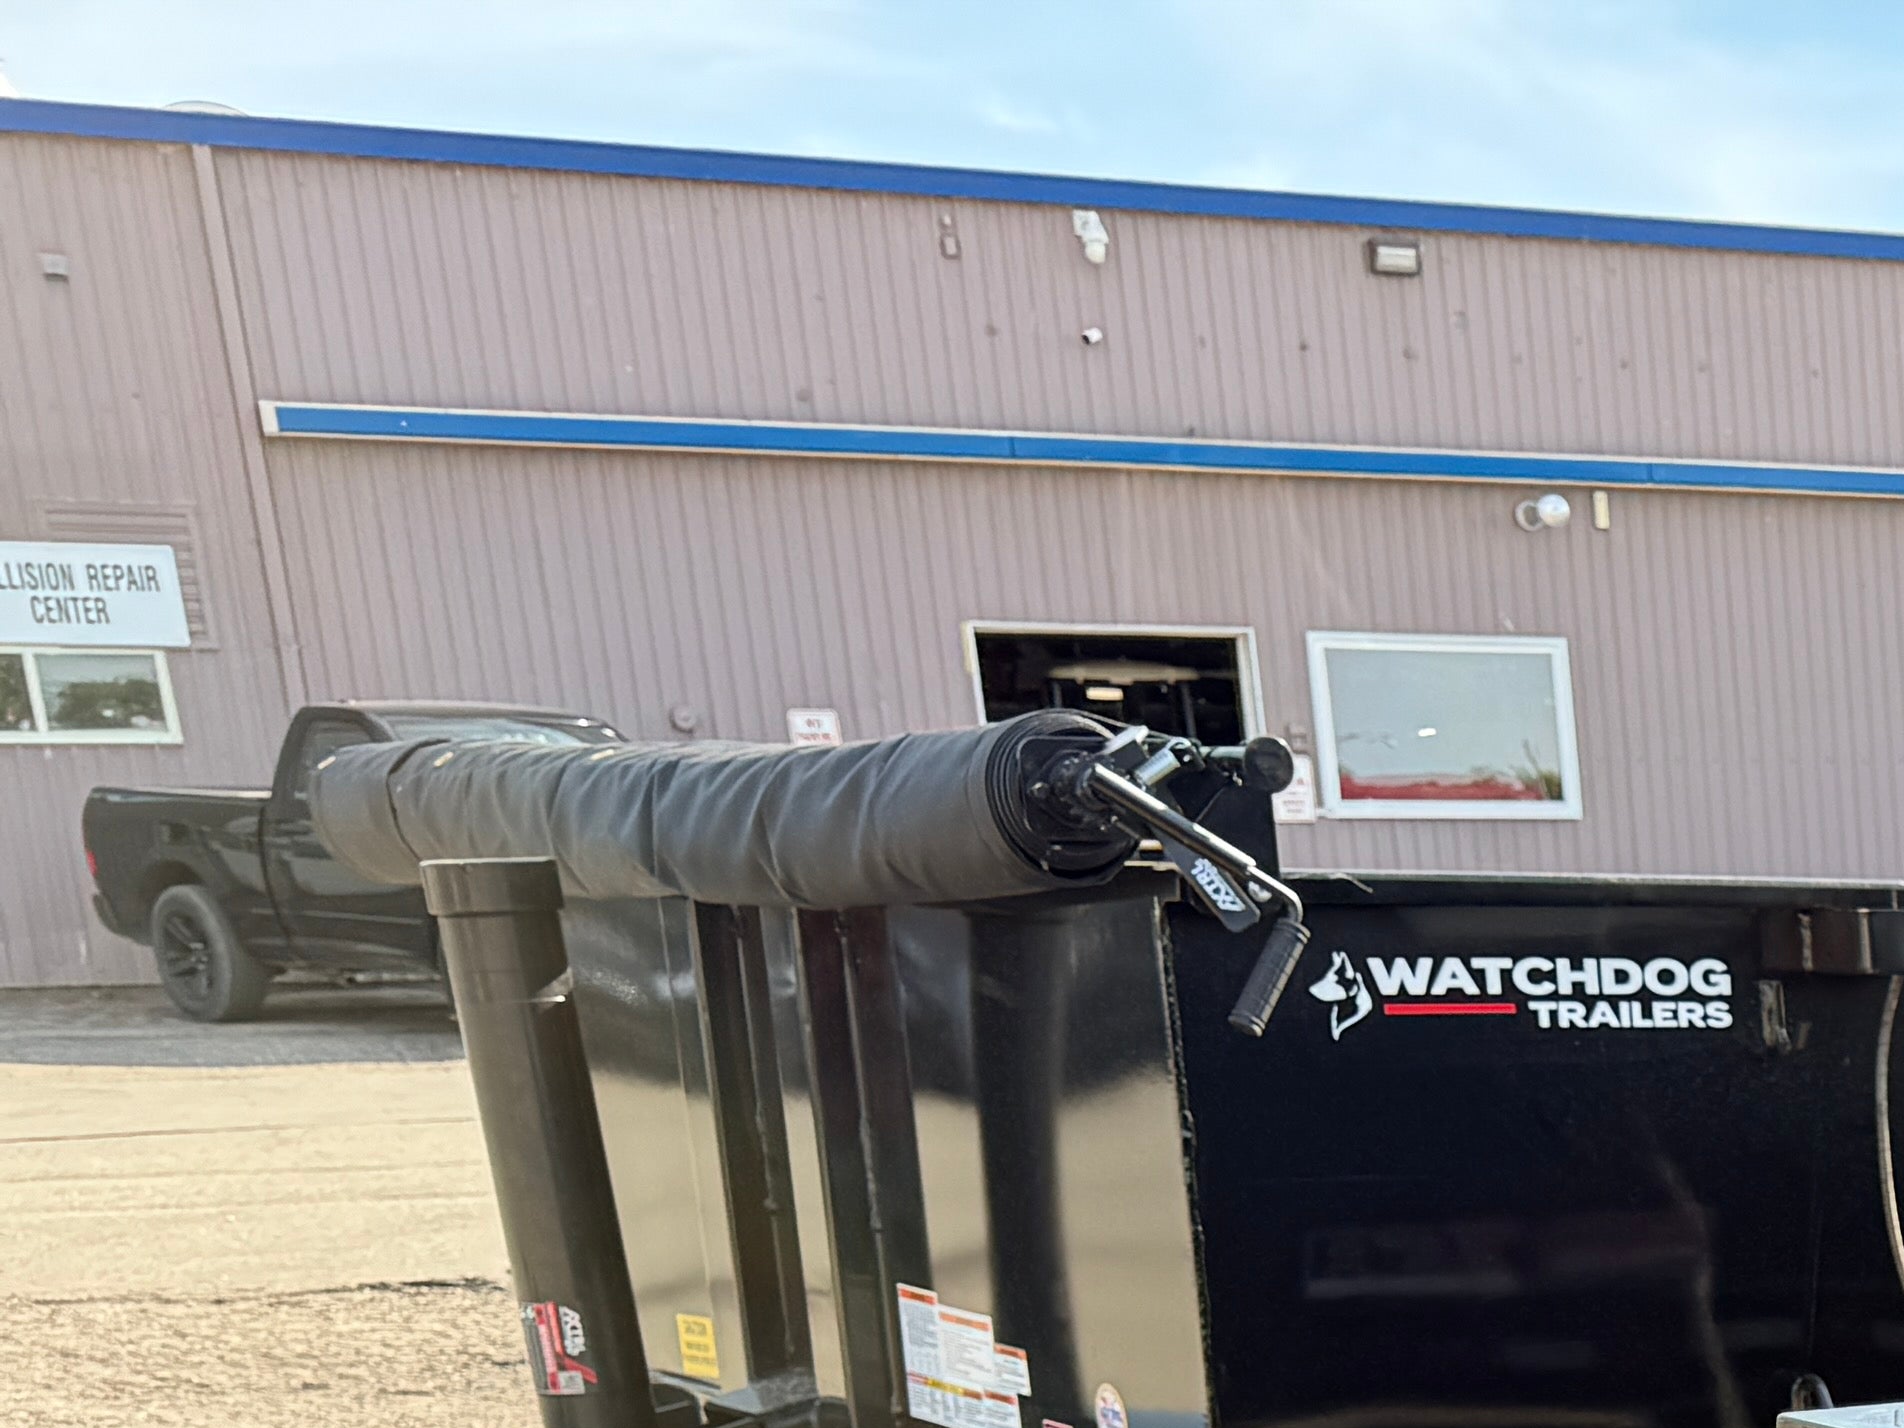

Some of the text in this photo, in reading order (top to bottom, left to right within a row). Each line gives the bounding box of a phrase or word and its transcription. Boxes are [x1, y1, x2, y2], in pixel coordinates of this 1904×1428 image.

[85, 564, 160, 591] REPAIR
[29, 596, 110, 624] CENTER
[1366, 957, 1733, 996] WATCHDOG
[1528, 1001, 1733, 1028] TRAILERS
